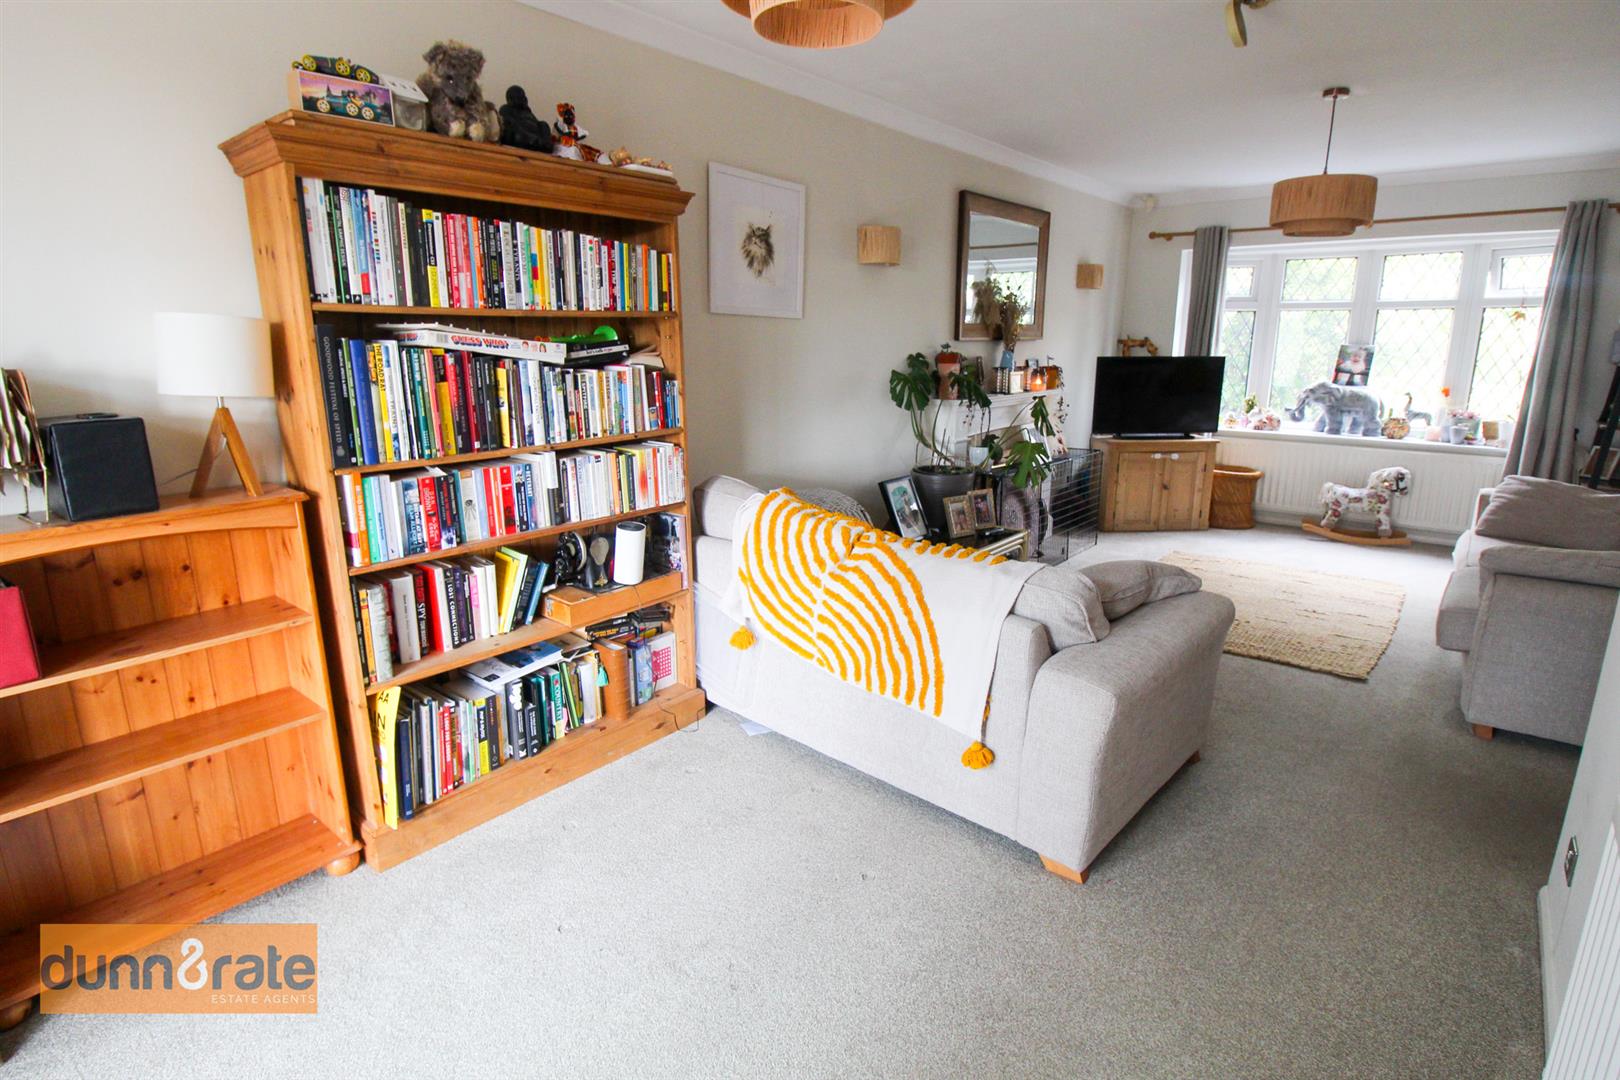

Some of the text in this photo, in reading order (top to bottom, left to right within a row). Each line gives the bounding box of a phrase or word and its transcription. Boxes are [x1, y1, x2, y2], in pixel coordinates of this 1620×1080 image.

[375, 345, 383, 357] THE
[377, 358, 385, 378] ROAD
[323, 336, 342, 444] GOODWOOD FESTIVAL OF SPEED
[416, 602, 427, 620] SPY
[447, 584, 459, 645] LOST CONNECTIONS
[554, 685, 563, 721] COUNTRY
